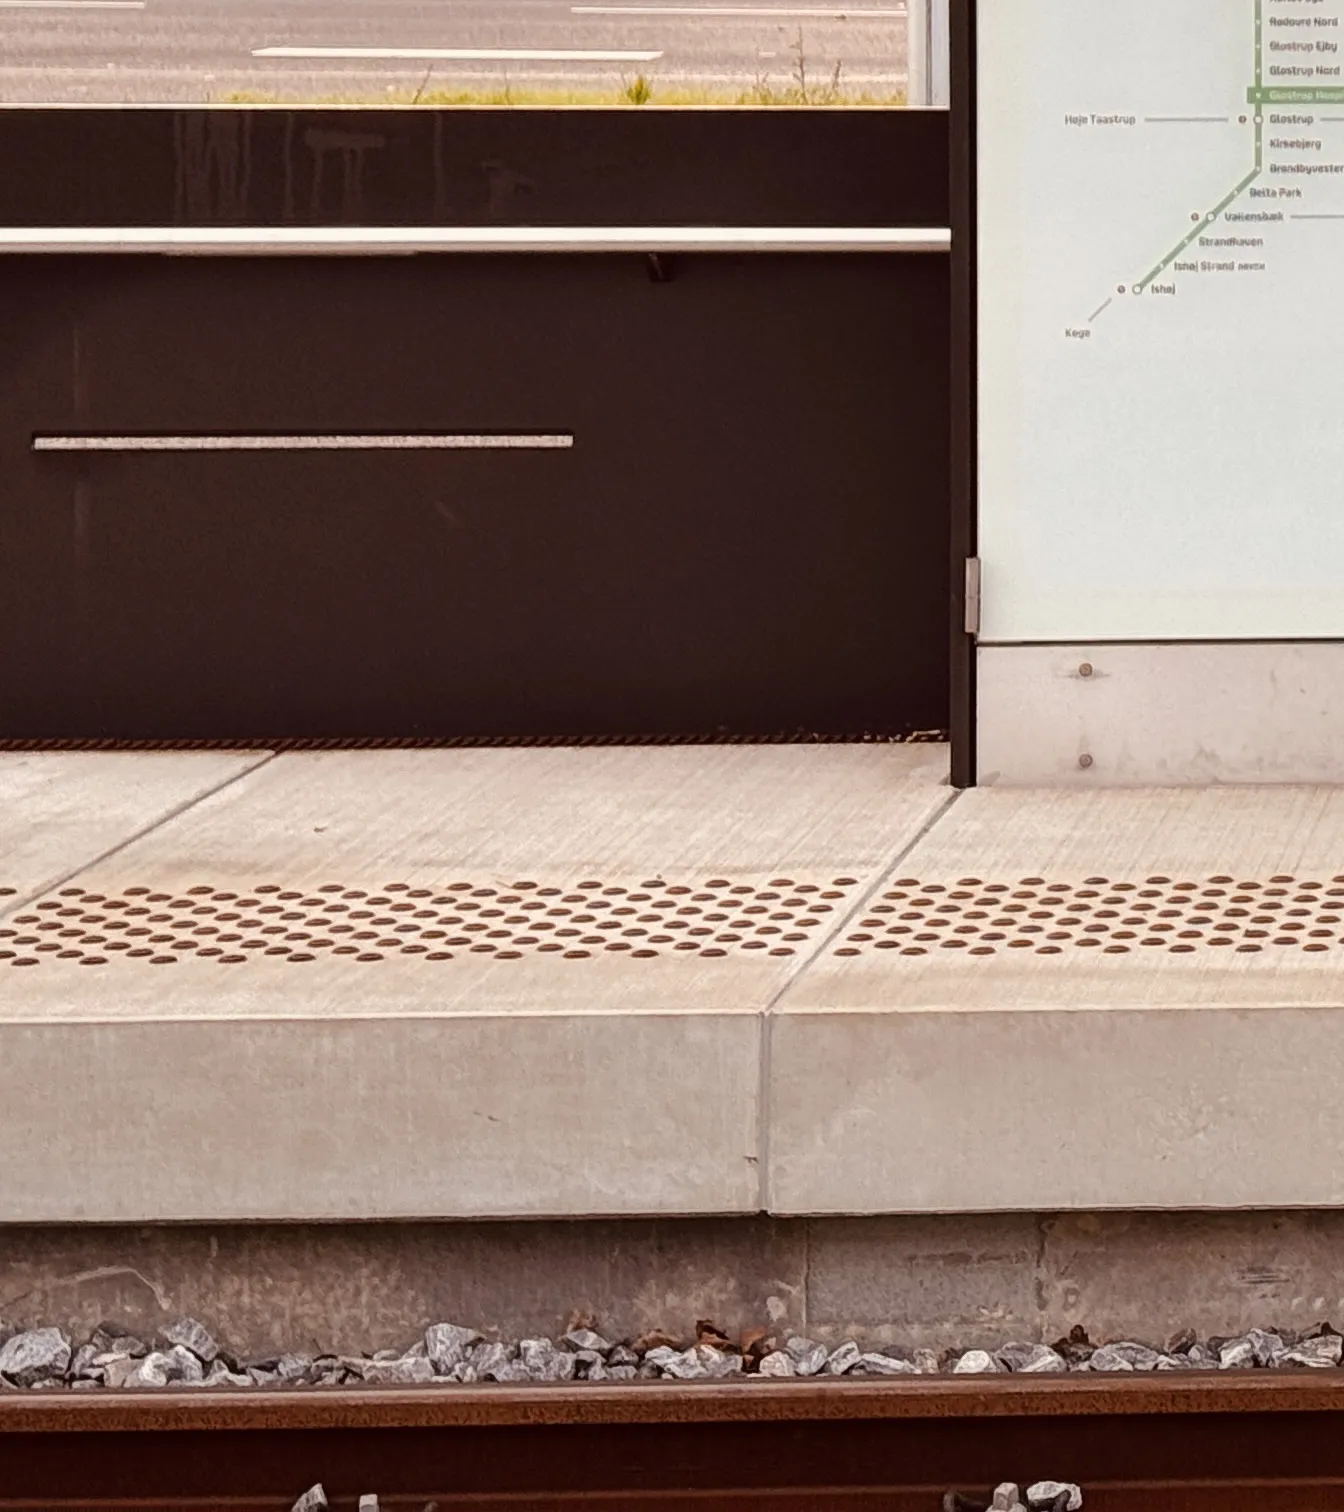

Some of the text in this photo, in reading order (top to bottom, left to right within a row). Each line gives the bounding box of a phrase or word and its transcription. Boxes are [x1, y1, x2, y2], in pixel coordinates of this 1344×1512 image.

[1314, 17, 1338, 27] Nord
[1269, 41, 1337, 53] Glostrup Ejby
[1270, 66, 1314, 77] Glostrup
[1316, 66, 1340, 76] Nord
[1269, 90, 1313, 100] Glostrup
[1090, 114, 1136, 125] Taastrup
[1270, 114, 1313, 126] Glostrup
[1249, 188, 1301, 198] Delta Park
[1199, 237, 1263, 247] Strandhaven
[1201, 261, 1234, 272] Strand
